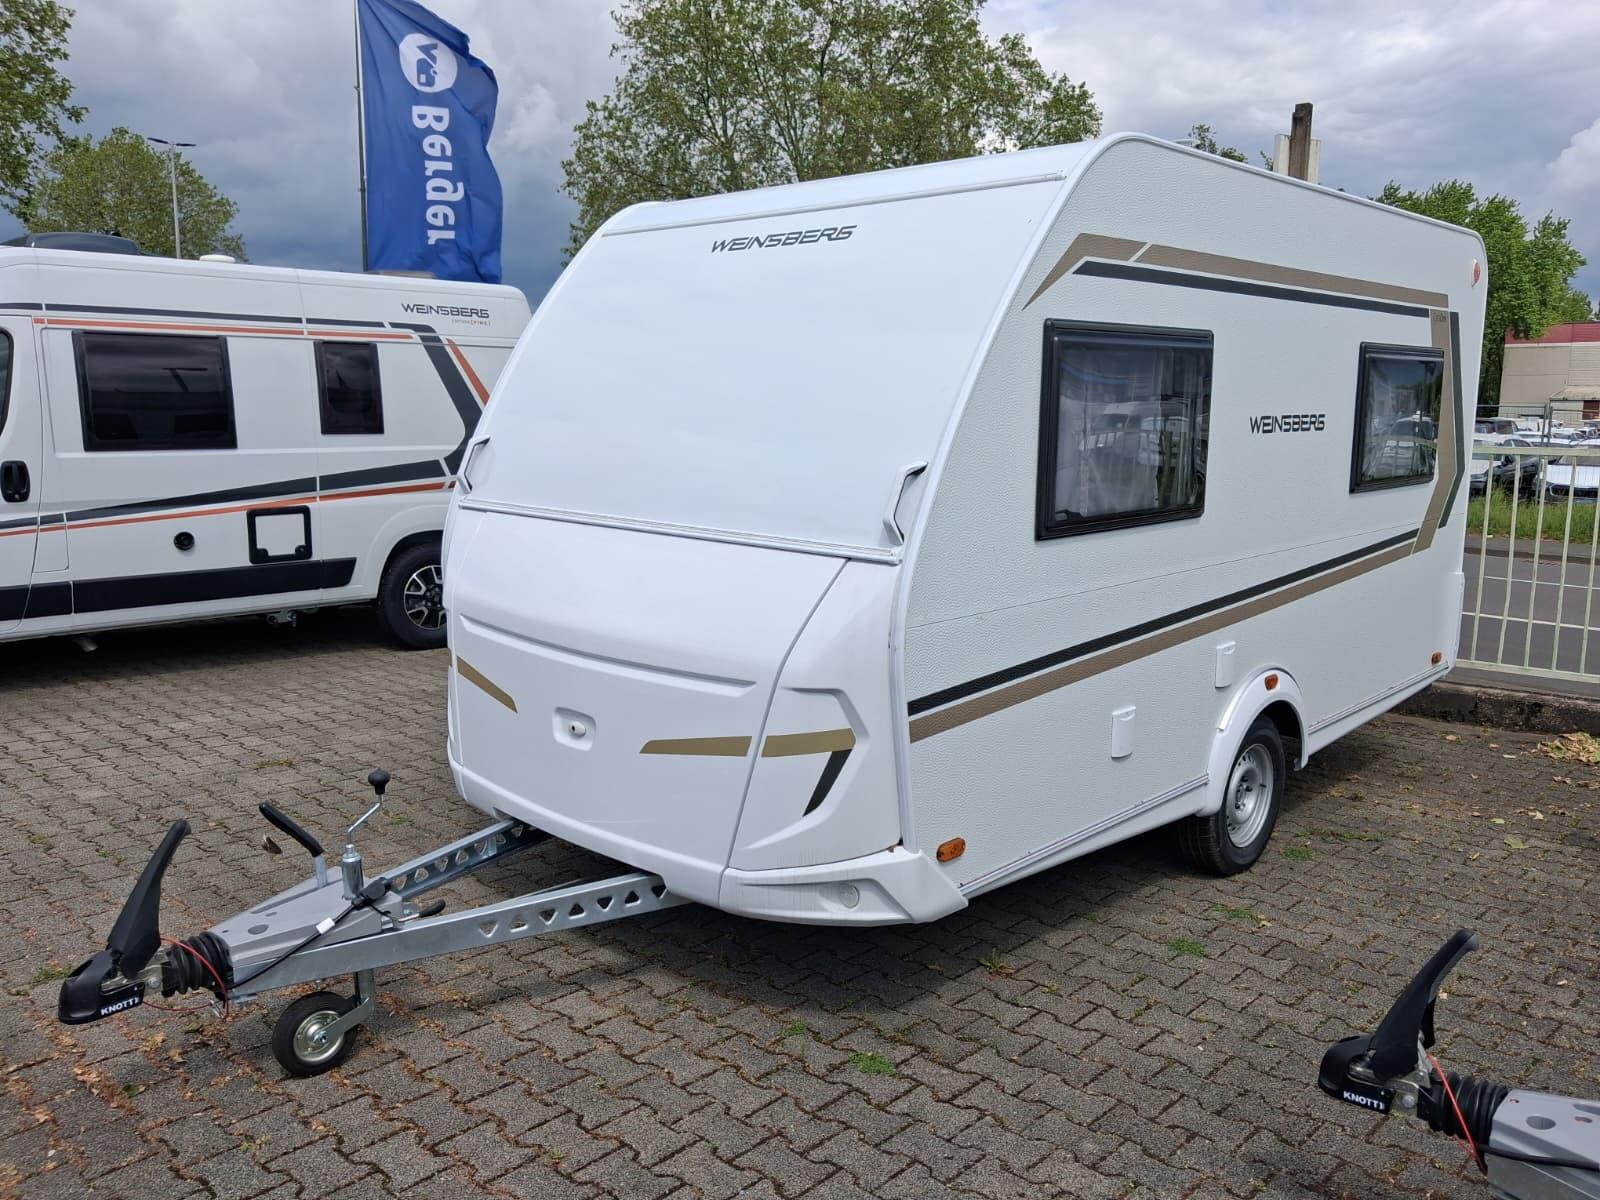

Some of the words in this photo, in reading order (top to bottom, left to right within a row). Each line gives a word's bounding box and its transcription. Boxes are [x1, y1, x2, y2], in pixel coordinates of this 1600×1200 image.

[711, 224, 858, 253] WEINSBERG
[401, 303, 490, 319] WEINSBERG
[1249, 413, 1326, 434] WEINSBERG
[100, 998, 135, 1016] KNOTT
[1343, 1090, 1380, 1108] KNOTT
